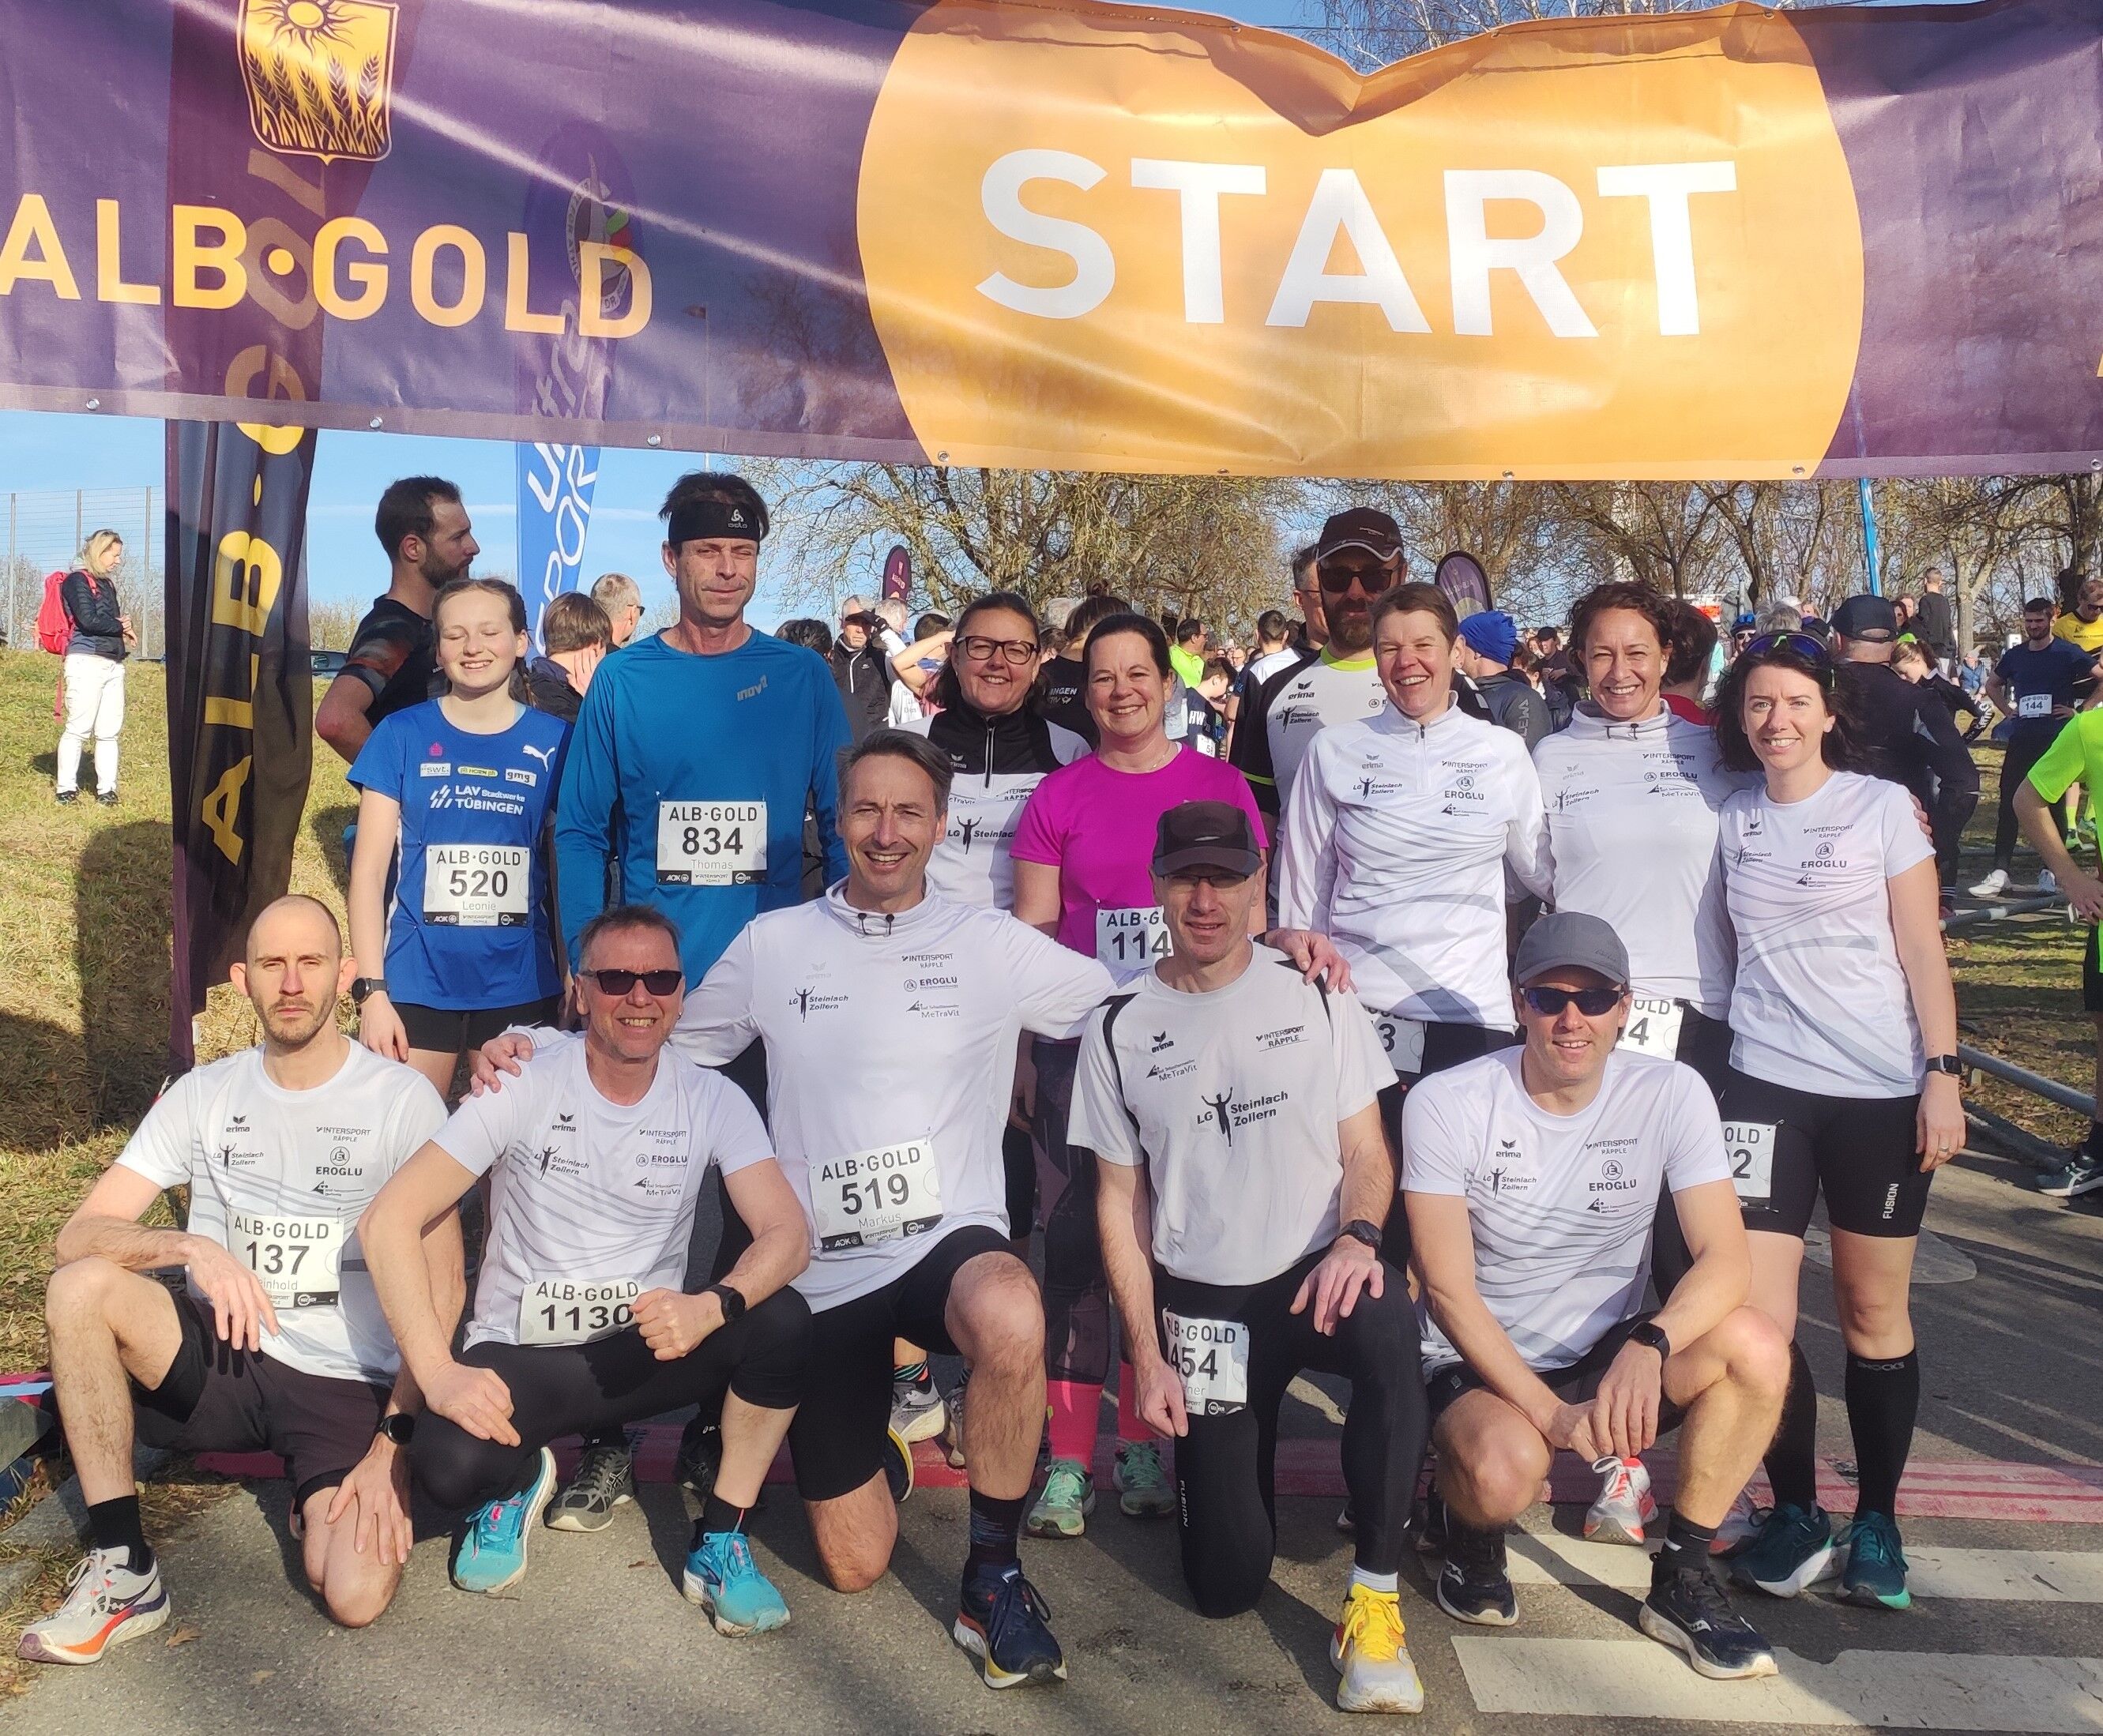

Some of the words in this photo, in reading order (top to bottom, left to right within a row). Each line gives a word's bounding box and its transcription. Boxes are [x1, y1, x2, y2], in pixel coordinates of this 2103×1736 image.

[976, 148, 1737, 338] START
[1289, 691, 1315, 700] erima
[2025, 701, 2043, 710] 144
[455, 785, 481, 796] LAV
[1444, 791, 1484, 800] EROGLU
[455, 798, 524, 815] TÜBINGEN
[683, 826, 743, 855] 834
[691, 859, 733, 870] Thomas
[1801, 860, 1847, 869] EROGLU
[449, 870, 508, 897] 520
[462, 901, 496, 911] Leonie
[1106, 911, 1160, 928] ALB·G
[1112, 930, 1172, 960] 114
[909, 953, 954, 962] INTERSPORT
[920, 976, 957, 986] EROGLU
[788, 998, 798, 1006] LG
[809, 994, 849, 1003] Steinlach
[1634, 1000, 1670, 1015] OLD
[1263, 1025, 1305, 1040] INTERSPORT
[1378, 1023, 1396, 1053] 3
[1627, 1017, 1650, 1046] 4
[1268, 1034, 1300, 1048] RÄPPLE
[1197, 1110, 1213, 1125] LG
[1230, 1091, 1289, 1114] Steinlach
[1234, 1107, 1277, 1128] Zollern
[324, 1127, 371, 1136] INTERSPORT
[551, 1124, 577, 1133] erima
[1725, 1126, 1760, 1144] OLD
[1593, 1138, 1638, 1148] INTERSPORT
[651, 1155, 688, 1163] EROGLU
[1732, 1148, 1752, 1179] 2
[316, 1167, 363, 1176] EROGLU
[1589, 1178, 1637, 1192] EROGLU
[842, 1174, 909, 1215] 519
[1883, 1183, 1899, 1219] FUSION
[859, 1212, 901, 1230] Markus
[246, 1241, 310, 1276] 137
[258, 1279, 298, 1291] einhold
[540, 1302, 634, 1332] 1130
[1170, 1343, 1218, 1381] 454
[1187, 1386, 1206, 1396] ner
